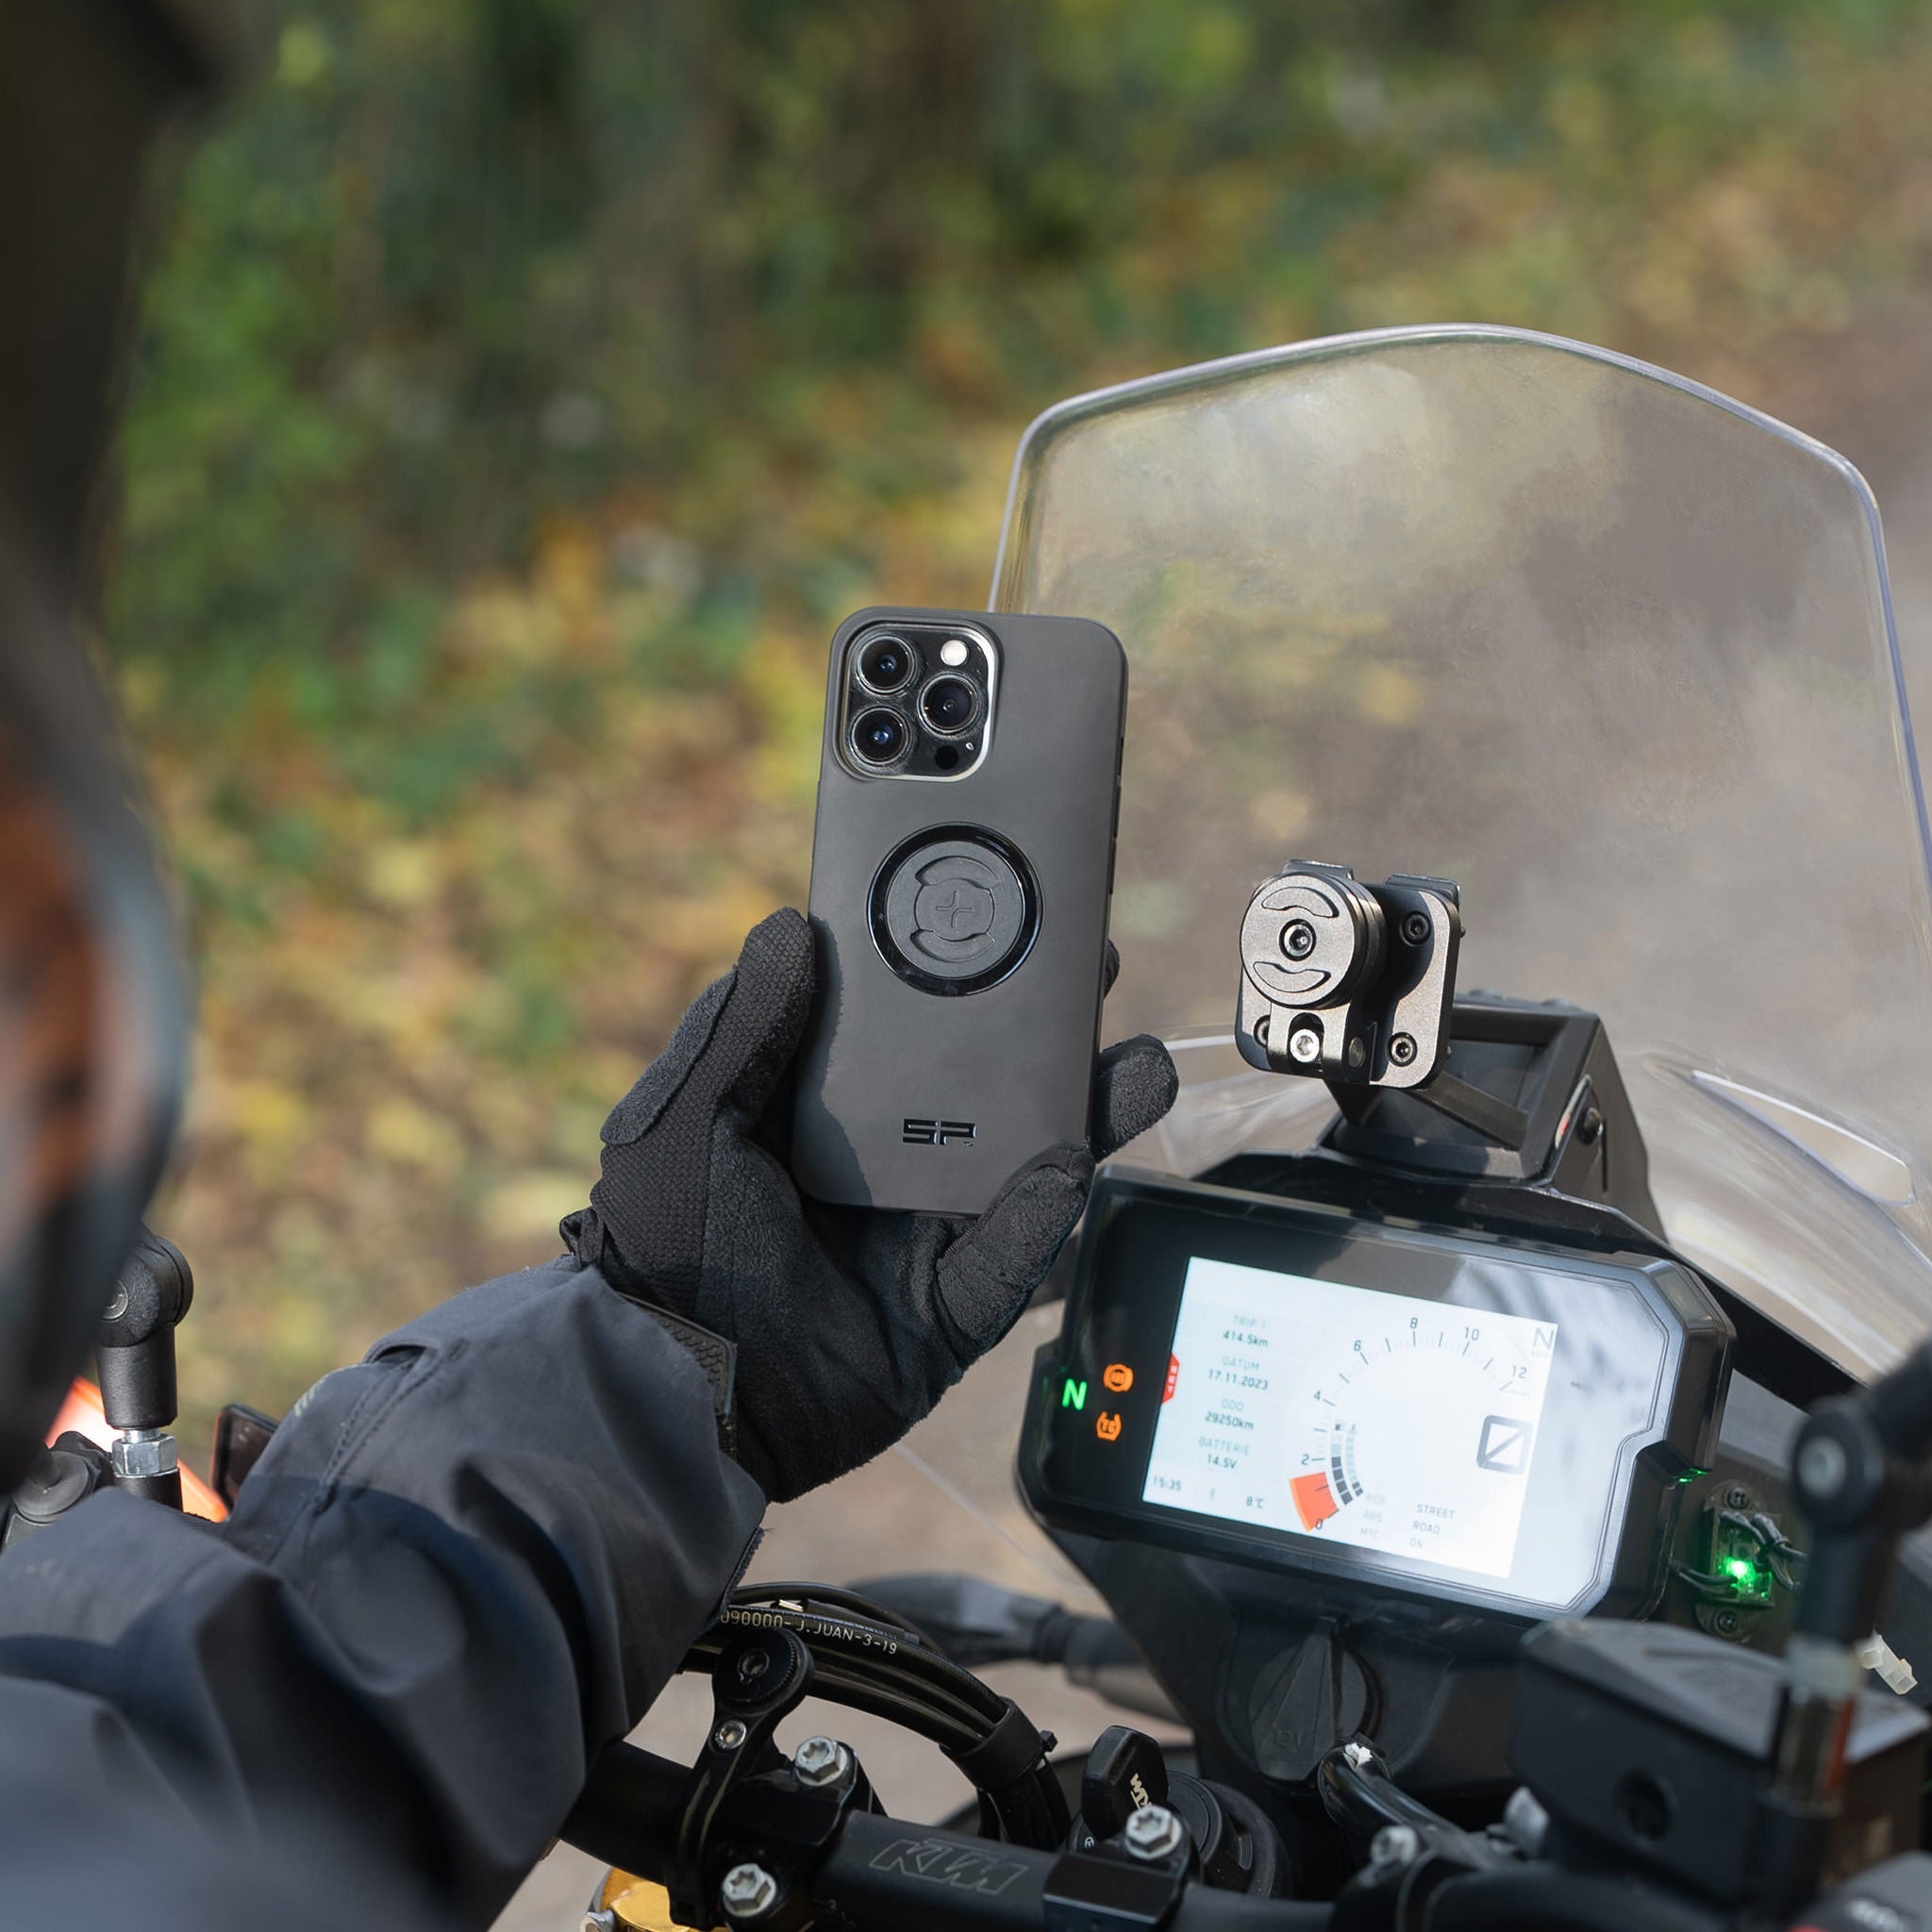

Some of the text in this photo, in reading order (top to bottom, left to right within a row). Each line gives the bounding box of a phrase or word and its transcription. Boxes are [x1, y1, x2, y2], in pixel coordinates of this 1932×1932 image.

[903, 1119, 976, 1145] SP
[1409, 1317, 1419, 1330] 8
[1223, 1330, 1269, 1348] 414.5km
[1464, 1326, 1480, 1341] 10
[1353, 1340, 1362, 1352] 6
[1222, 1356, 1260, 1372] DATUM
[1511, 1365, 1528, 1379] 12
[1208, 1369, 1269, 1391] 17.11.2023
[1062, 1378, 1088, 1410] N
[1313, 1390, 1322, 1401] 4
[1204, 1411, 1255, 1431] 29250km
[1198, 1436, 1251, 1456] BATTERIE
[1207, 1454, 1238, 1470] 14.5V
[1301, 1454, 1310, 1465] 2
[1416, 1503, 1456, 1520] STREET
[1411, 1520, 1441, 1535] ROAD
[869, 1839, 1030, 1895] KTM
